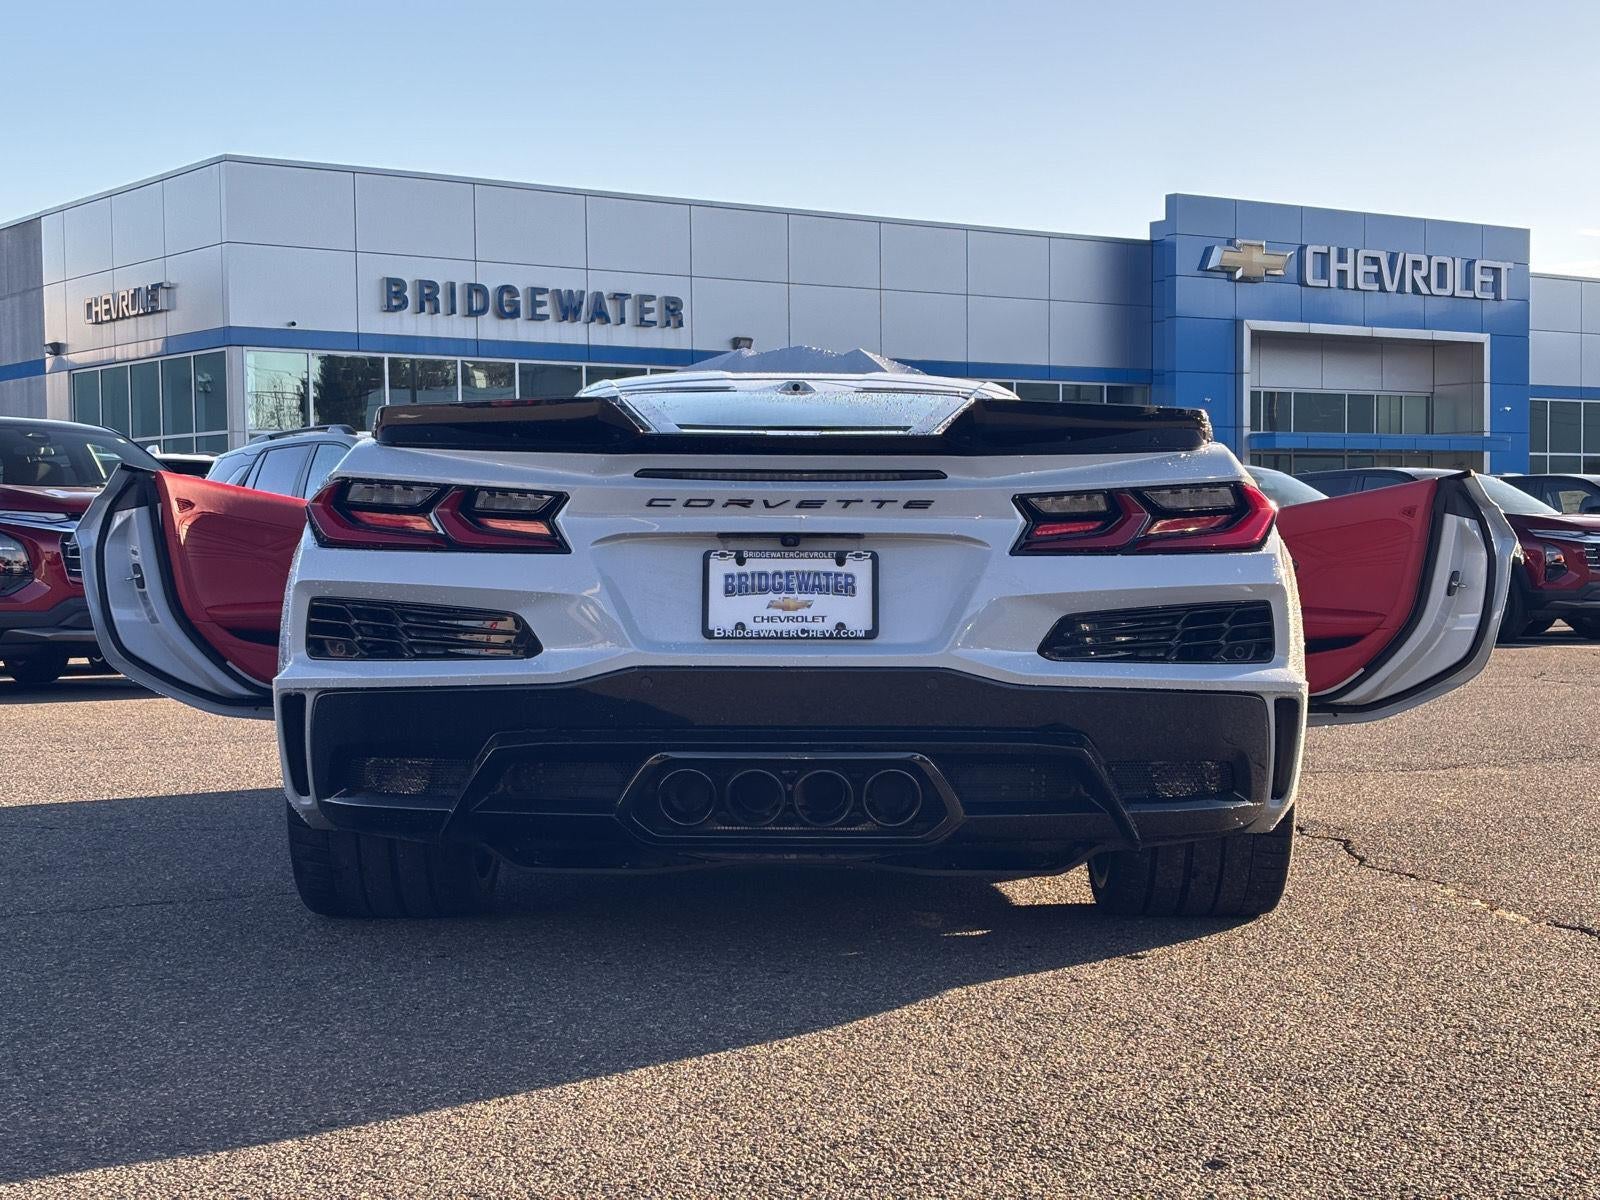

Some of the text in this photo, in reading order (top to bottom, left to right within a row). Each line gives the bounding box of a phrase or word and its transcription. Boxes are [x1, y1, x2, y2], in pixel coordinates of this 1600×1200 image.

[1304, 244, 1514, 300] CHEVROLET
[84, 282, 173, 324] CHEVROLET
[382, 276, 684, 328] BRIDGEWATER
[645, 498, 935, 510] CORVETTE
[723, 570, 857, 597] BRIDGEWATER
[753, 615, 827, 623] CHEVROLET
